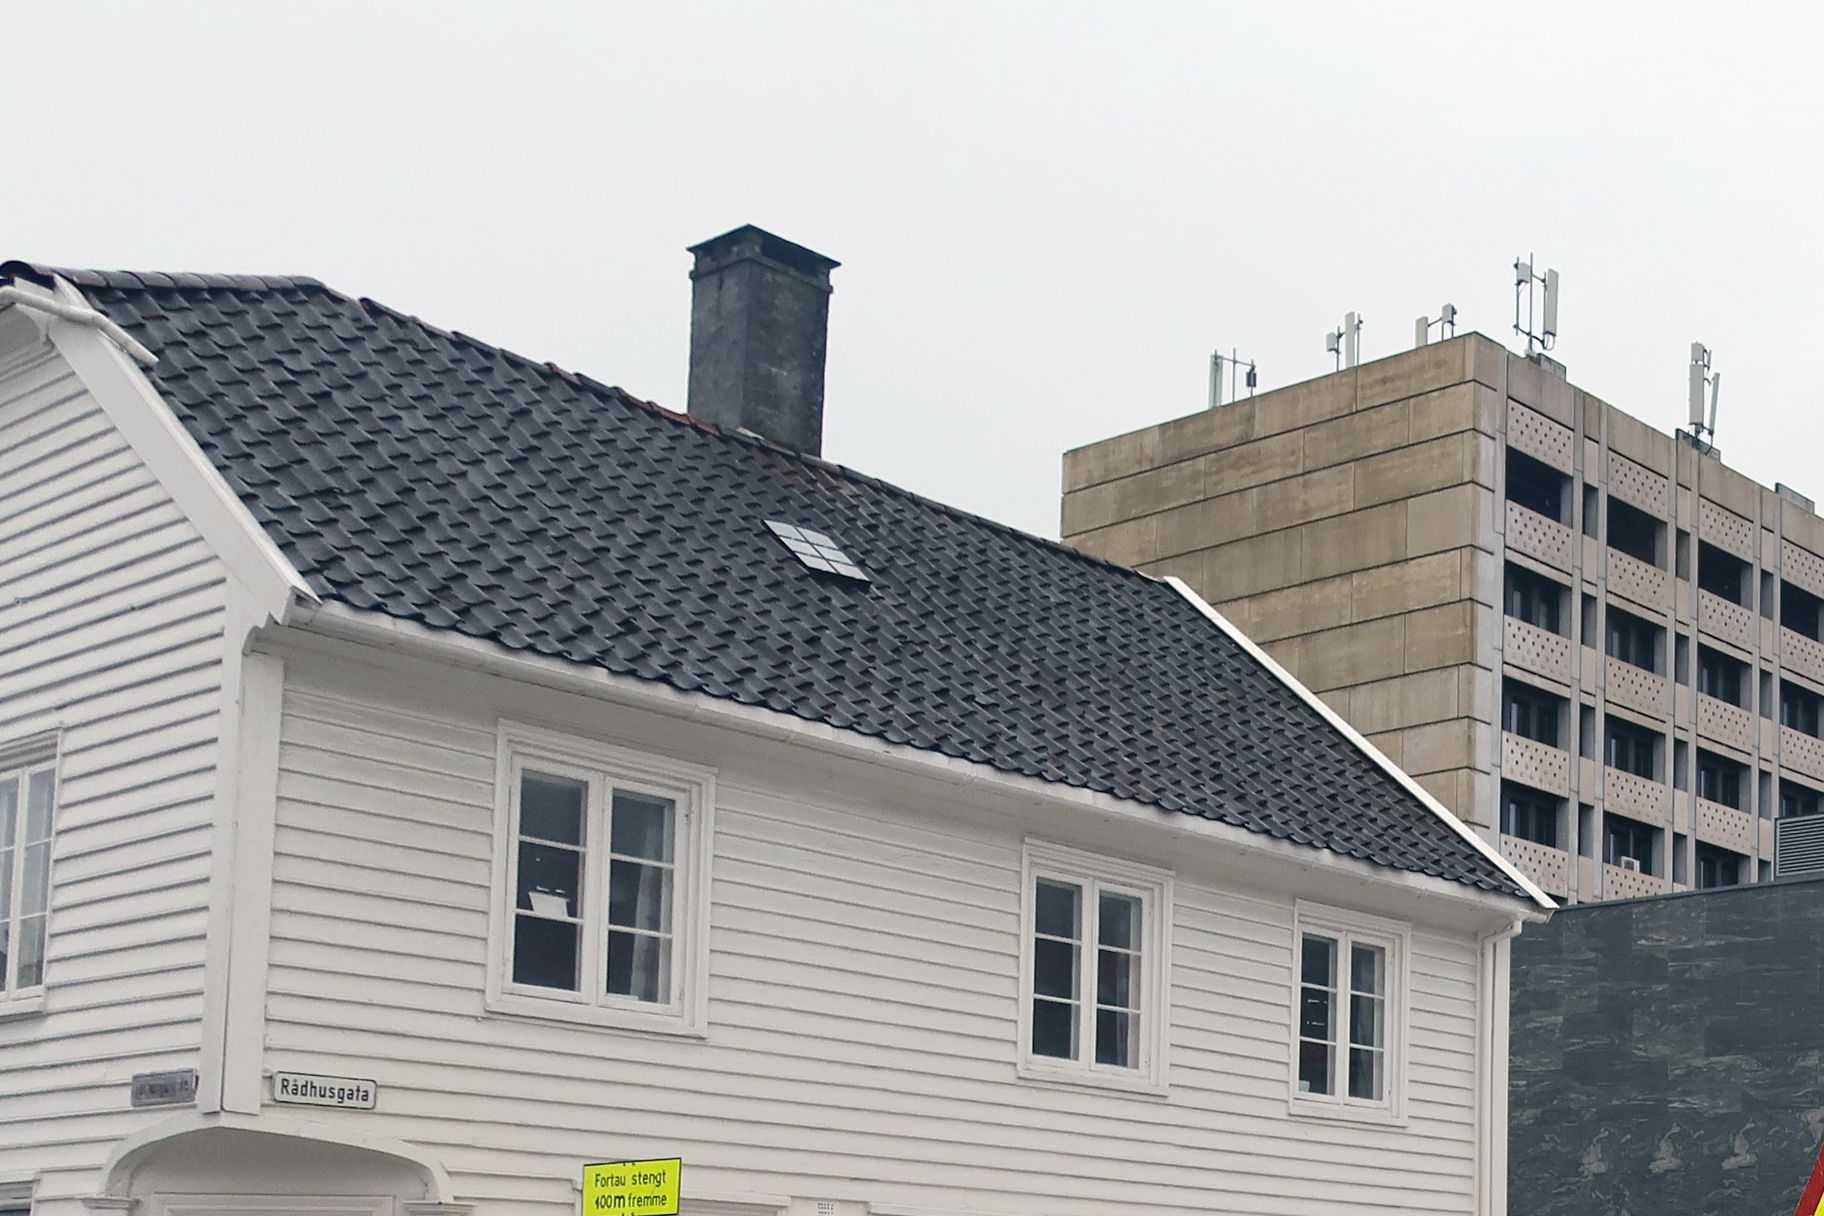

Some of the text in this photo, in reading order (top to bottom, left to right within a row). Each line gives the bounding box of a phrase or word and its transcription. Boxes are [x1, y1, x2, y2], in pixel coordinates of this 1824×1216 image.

[281, 1078, 369, 1103] Rådhusgata
[594, 1170, 666, 1187] Fortau stengt
[628, 1193, 667, 1207] fremme
